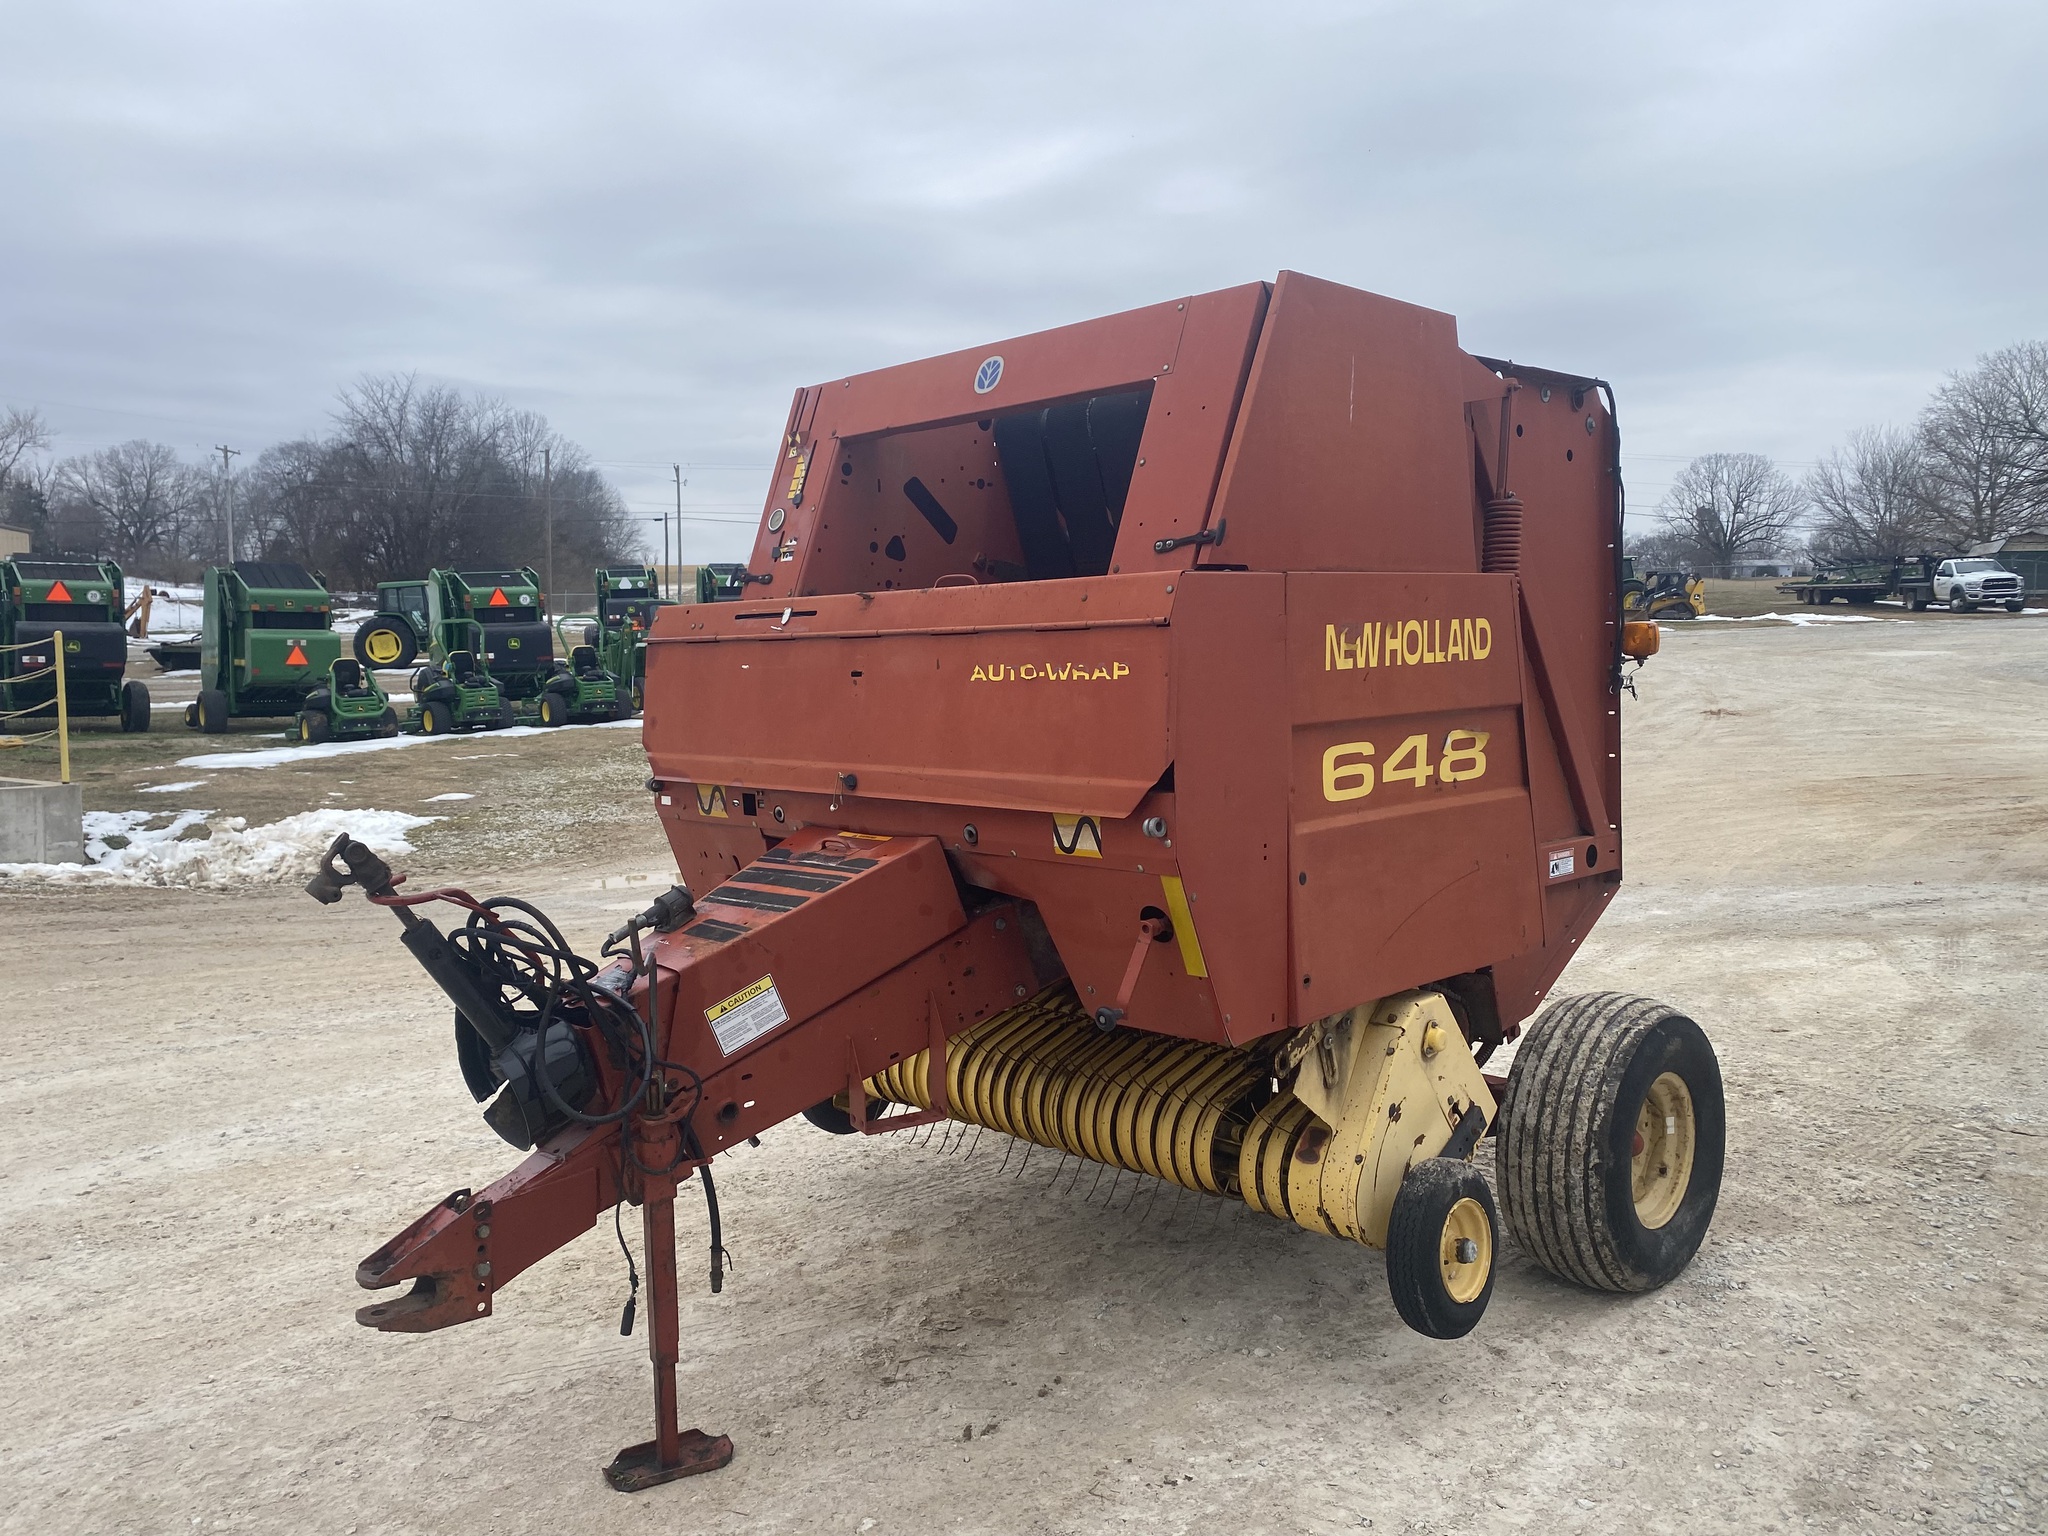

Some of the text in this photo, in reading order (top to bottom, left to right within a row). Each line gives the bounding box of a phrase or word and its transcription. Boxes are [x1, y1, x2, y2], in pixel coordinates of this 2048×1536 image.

[1385, 617, 1492, 667] HOLLAND
[970, 661, 1131, 682] AUTO-WRAP
[1322, 729, 1490, 802] 648
[727, 984, 762, 1008] CAUTION
